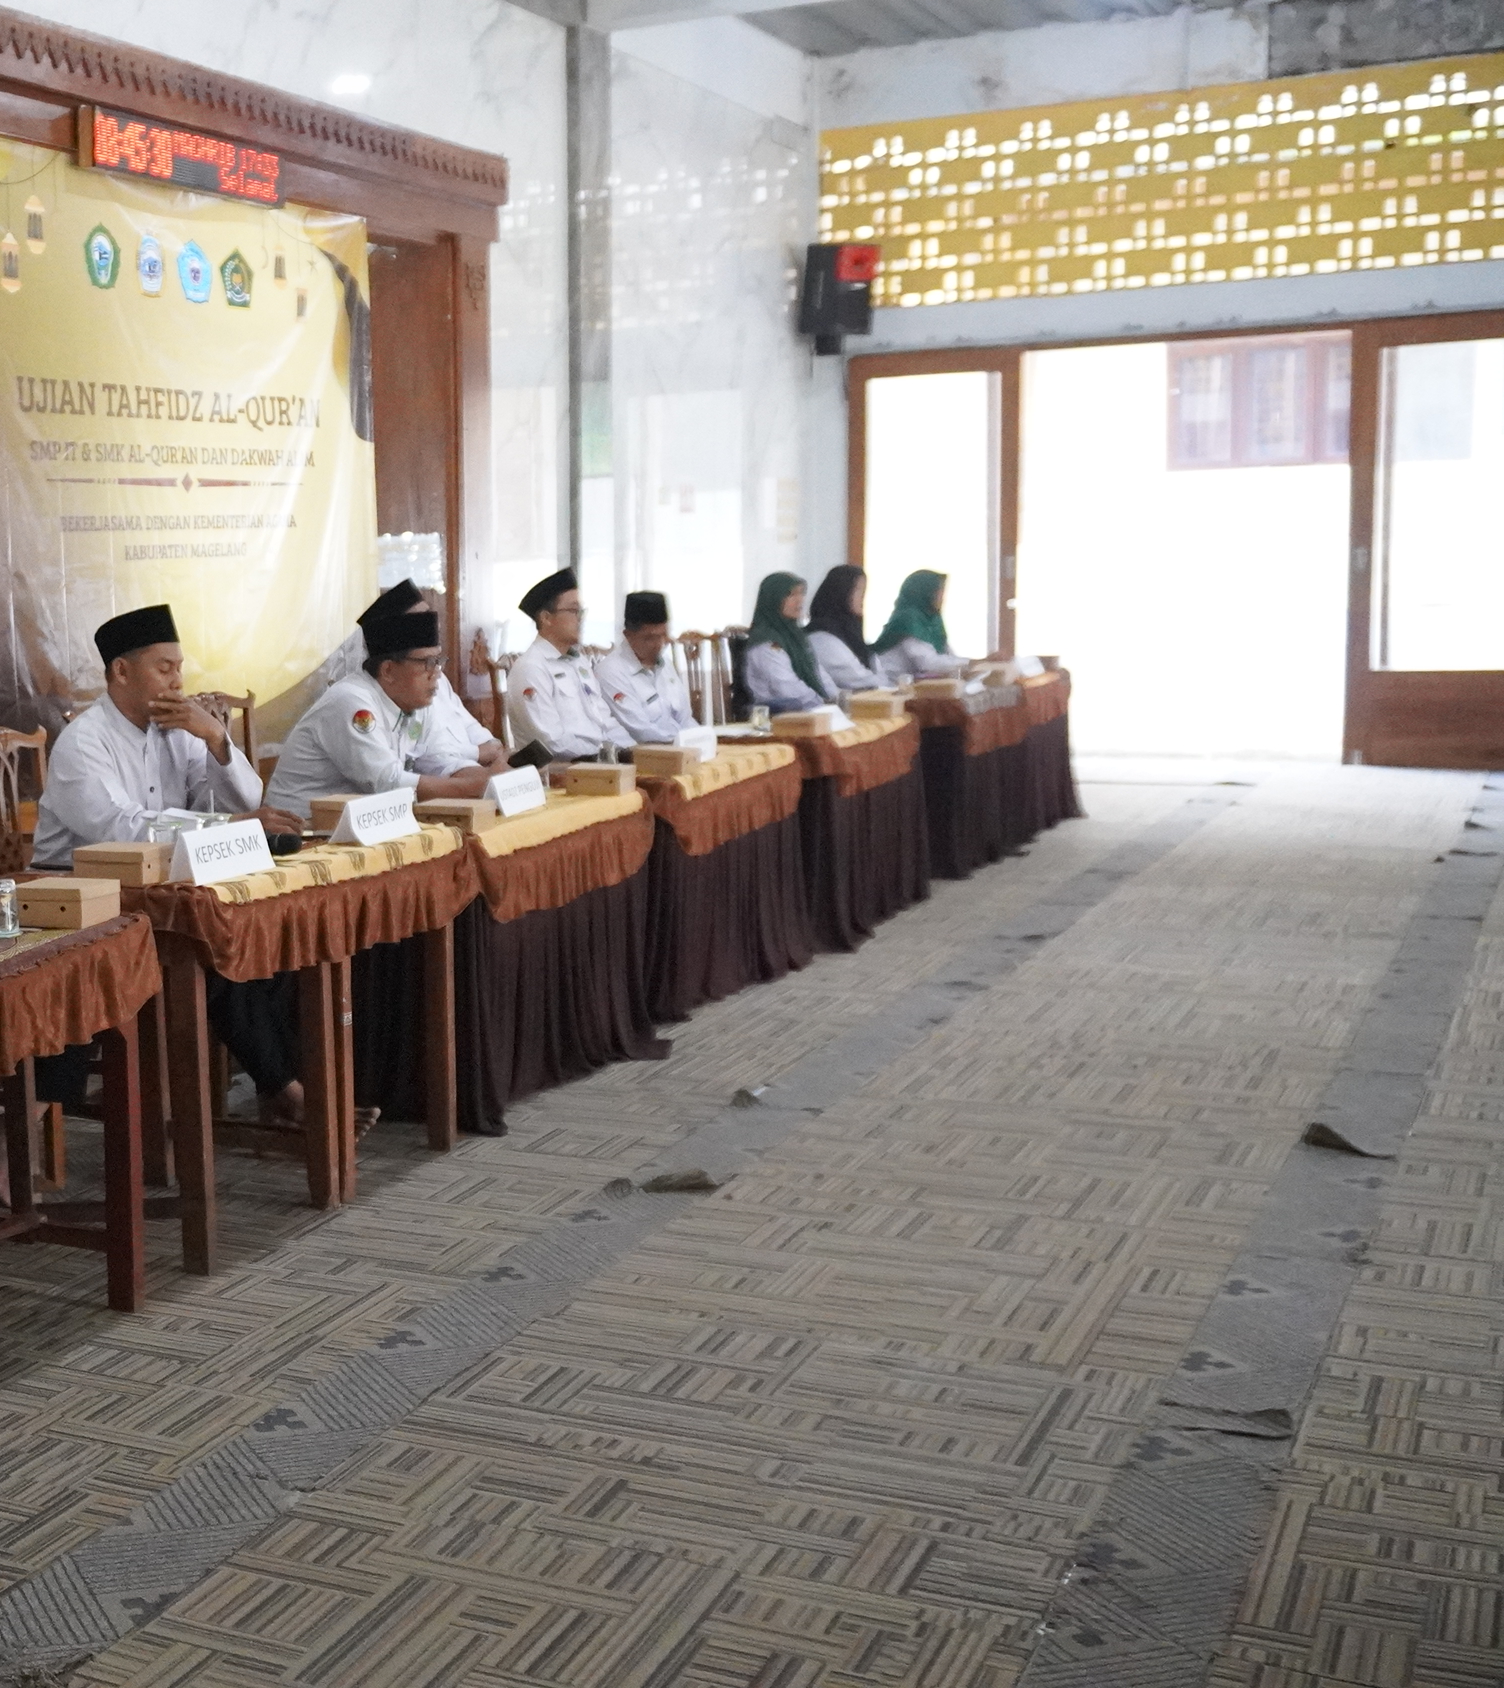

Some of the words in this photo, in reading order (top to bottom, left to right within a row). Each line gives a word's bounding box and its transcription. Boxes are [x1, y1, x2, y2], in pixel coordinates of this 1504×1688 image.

[16, 375, 96, 415] UJIAN
[102, 383, 204, 422] TAHFIDZ
[209, 391, 321, 432] AL-QUR'AN
[30, 440, 61, 461] SMP
[81, 442, 92, 462] &
[96, 443, 125, 463] SMK
[128, 444, 198, 467] AL-QUR'AN
[201, 448, 228, 465] DAN
[60, 515, 143, 532] BEKERJASAMA
[145, 515, 191, 530] DENGAN
[193, 514, 263, 530] KEMENTERIAN
[125, 544, 188, 561] KABUPATEN
[190, 542, 247, 558] MAGELANG
[356, 809, 389, 830] KEPSEK
[389, 803, 408, 822] SMP
[194, 841, 235, 864] KEPSEK
[235, 834, 262, 855] SMK
